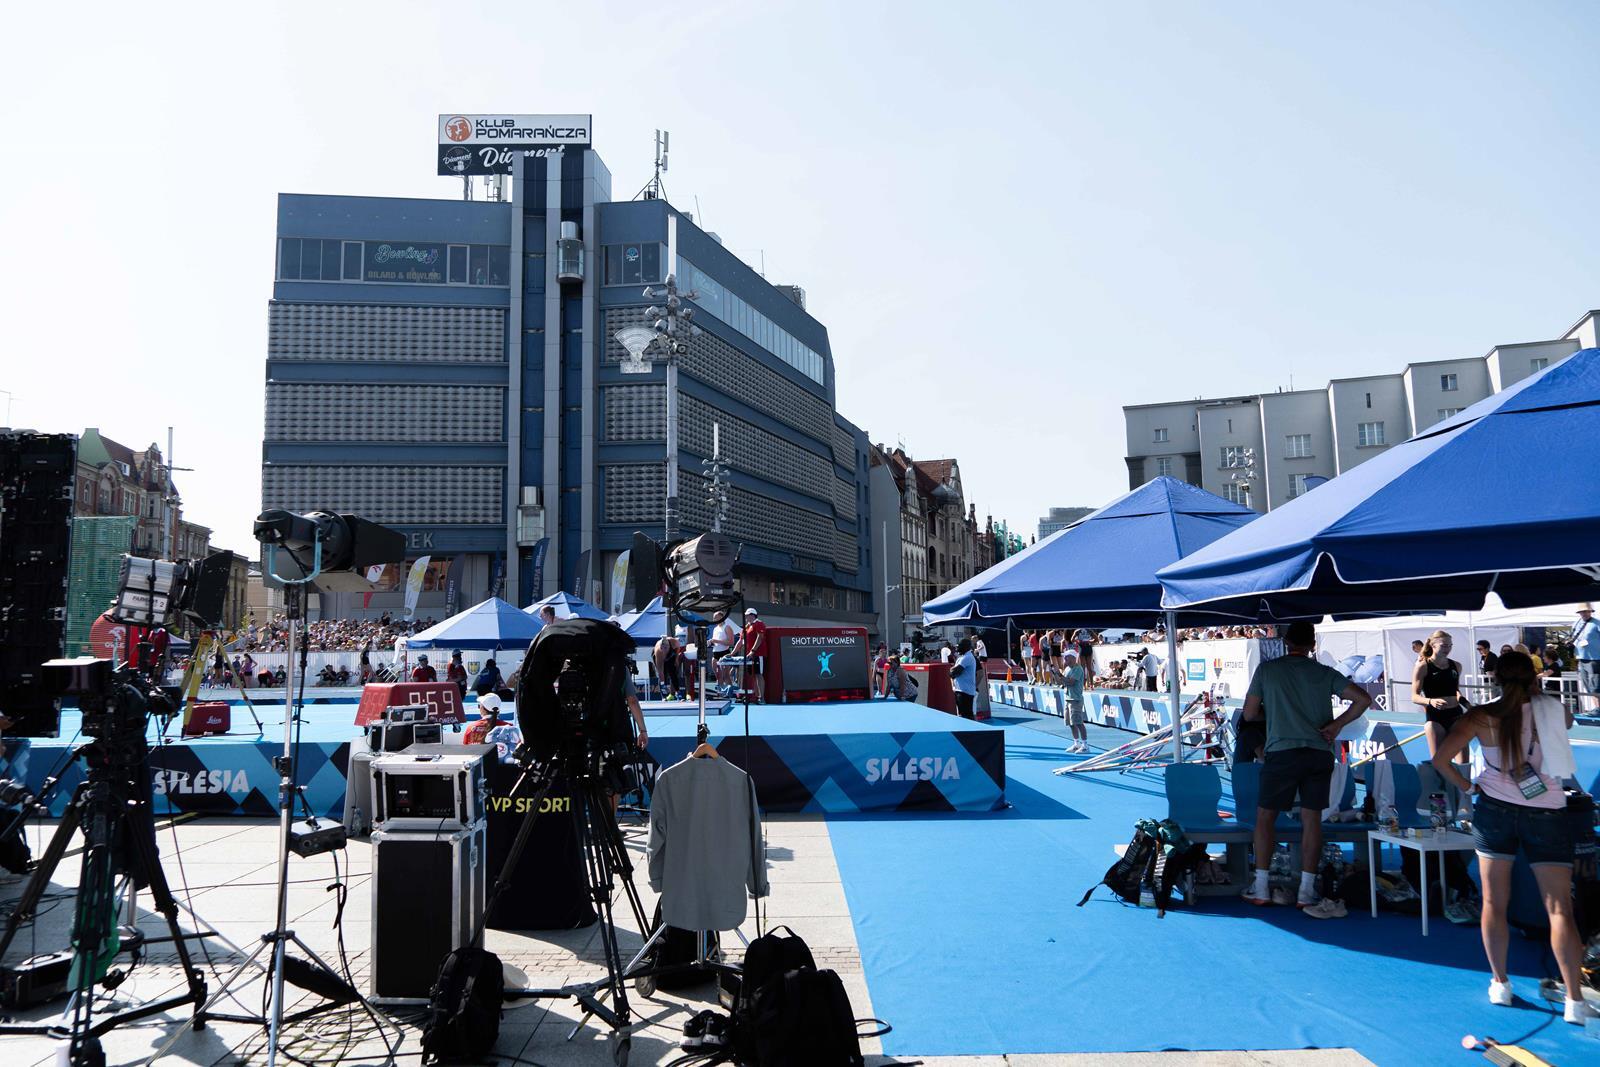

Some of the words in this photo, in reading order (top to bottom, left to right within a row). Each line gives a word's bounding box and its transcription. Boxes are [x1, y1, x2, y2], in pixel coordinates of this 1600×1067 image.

[475, 119, 515, 128] KLUB
[475, 125, 587, 139] POMARAŃCZA
[791, 637, 811, 645] SHOT
[812, 637, 825, 645] PUT
[826, 636, 856, 645] WOMEN
[865, 756, 960, 784] SILESIA
[153, 768, 250, 795] SILESIA
